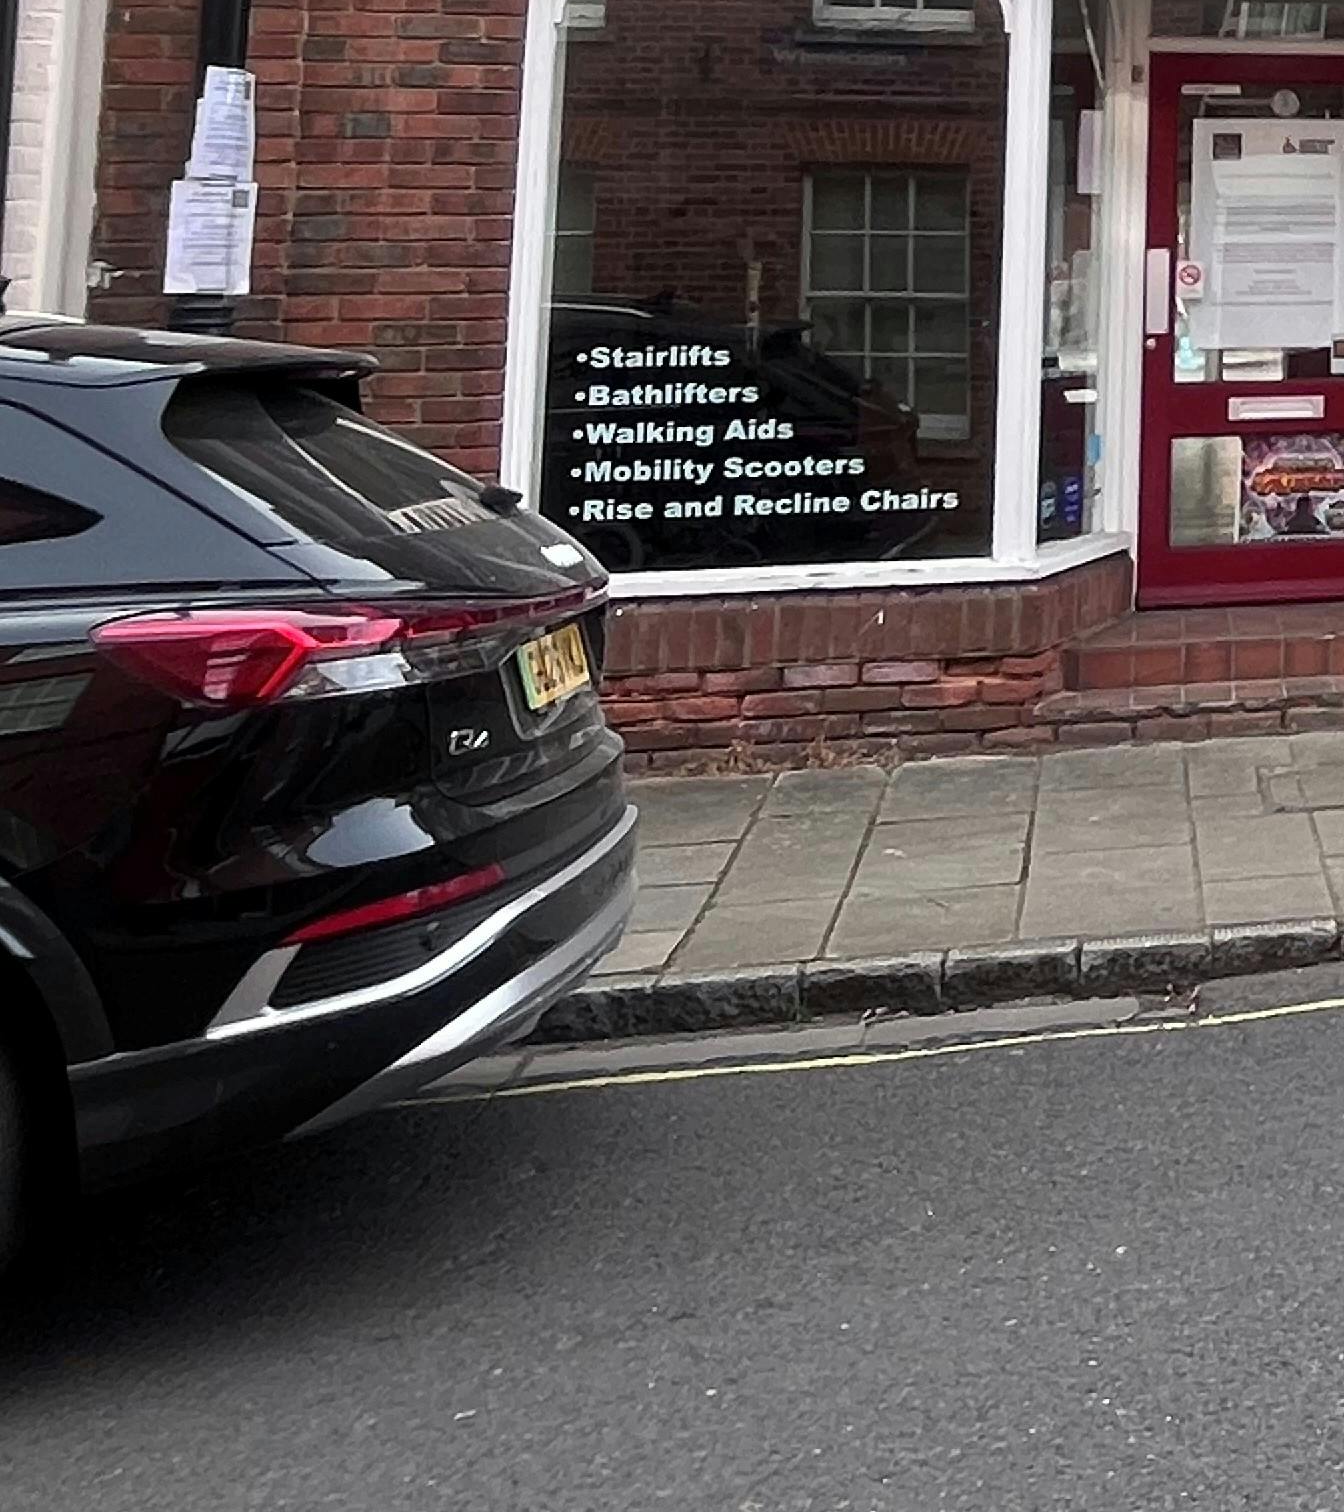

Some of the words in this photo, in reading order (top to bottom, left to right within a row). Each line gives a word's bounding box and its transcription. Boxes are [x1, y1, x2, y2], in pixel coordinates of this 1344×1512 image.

[589, 344, 731, 369] Stairlifts
[587, 382, 760, 406] Bathlifters
[585, 421, 714, 447] Walking
[723, 418, 794, 441] Aids
[583, 458, 714, 486] Mobility
[723, 456, 865, 478] Scooters
[581, 498, 654, 522] Rise
[663, 494, 723, 518] and
[733, 492, 851, 516] Recline
[860, 488, 960, 512] Chairs
